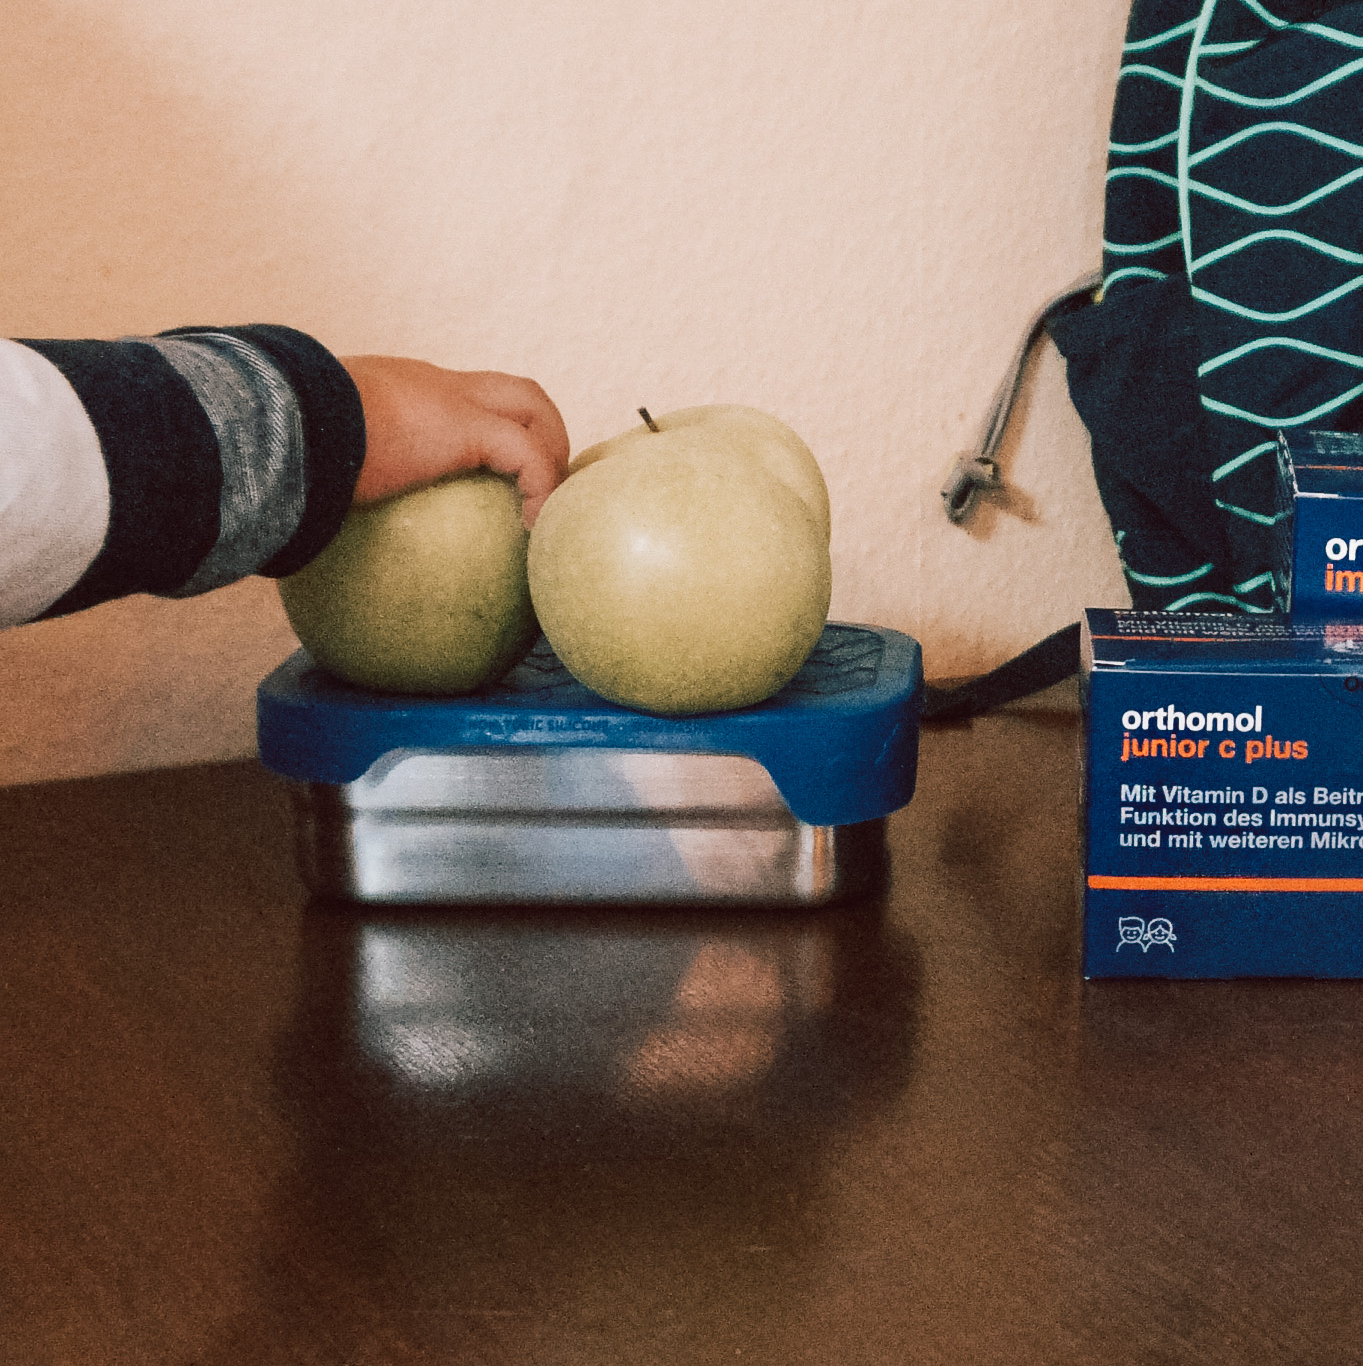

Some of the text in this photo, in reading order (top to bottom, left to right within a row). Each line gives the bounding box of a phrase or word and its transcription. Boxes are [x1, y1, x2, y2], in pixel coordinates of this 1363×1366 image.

[1122, 704, 1262, 732] orthomol
[1121, 732, 1308, 764] junior c plus
[1121, 784, 1156, 802] Mit
[1162, 786, 1244, 803] Vitamin
[1253, 787, 1268, 803] D
[1275, 787, 1306, 804] als
[1121, 807, 1216, 825] Funktion
[1224, 809, 1262, 826] des
[1120, 831, 1160, 847] und
[1169, 831, 1202, 848] mit
[1209, 832, 1303, 848] weiteren
